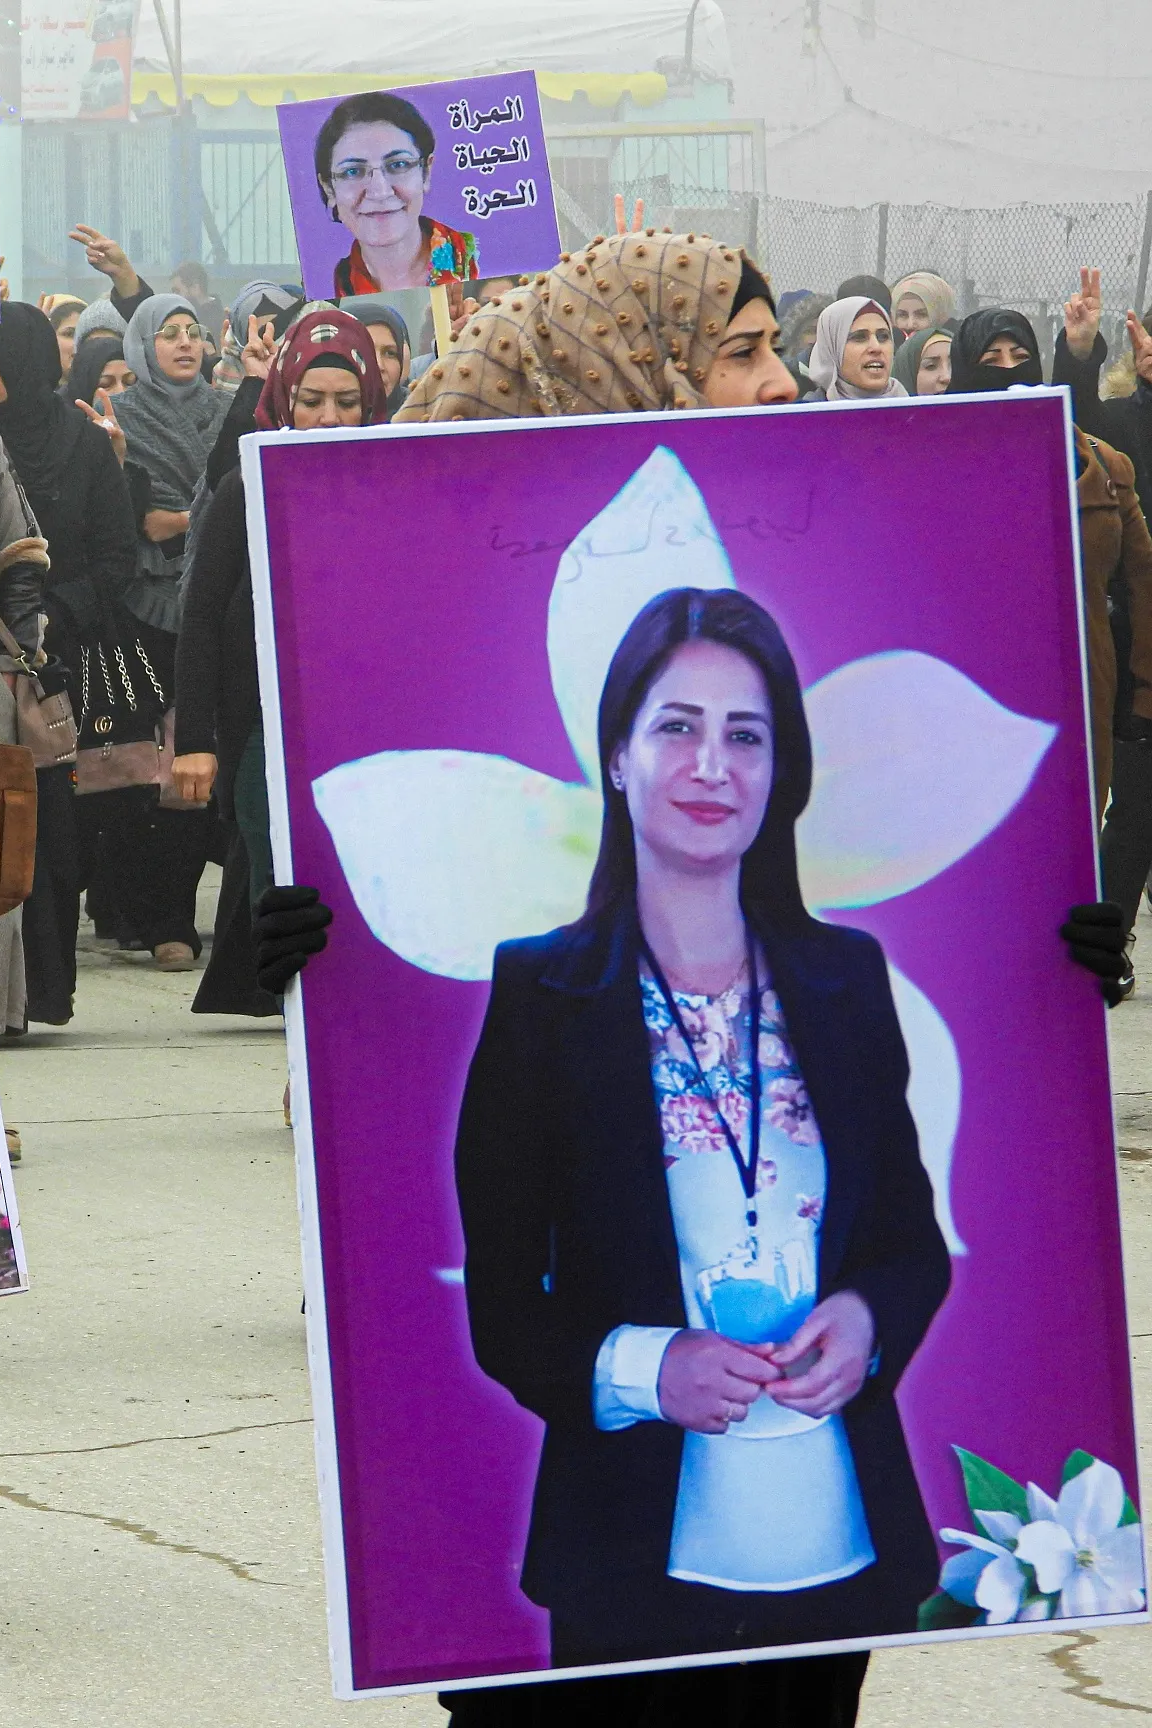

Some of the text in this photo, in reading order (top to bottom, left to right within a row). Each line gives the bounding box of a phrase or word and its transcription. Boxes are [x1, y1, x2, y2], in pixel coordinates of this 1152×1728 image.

[447, 96, 524, 132] المرأة
[453, 136, 530, 174] الحياة
[462, 179, 537, 218] الحرة
